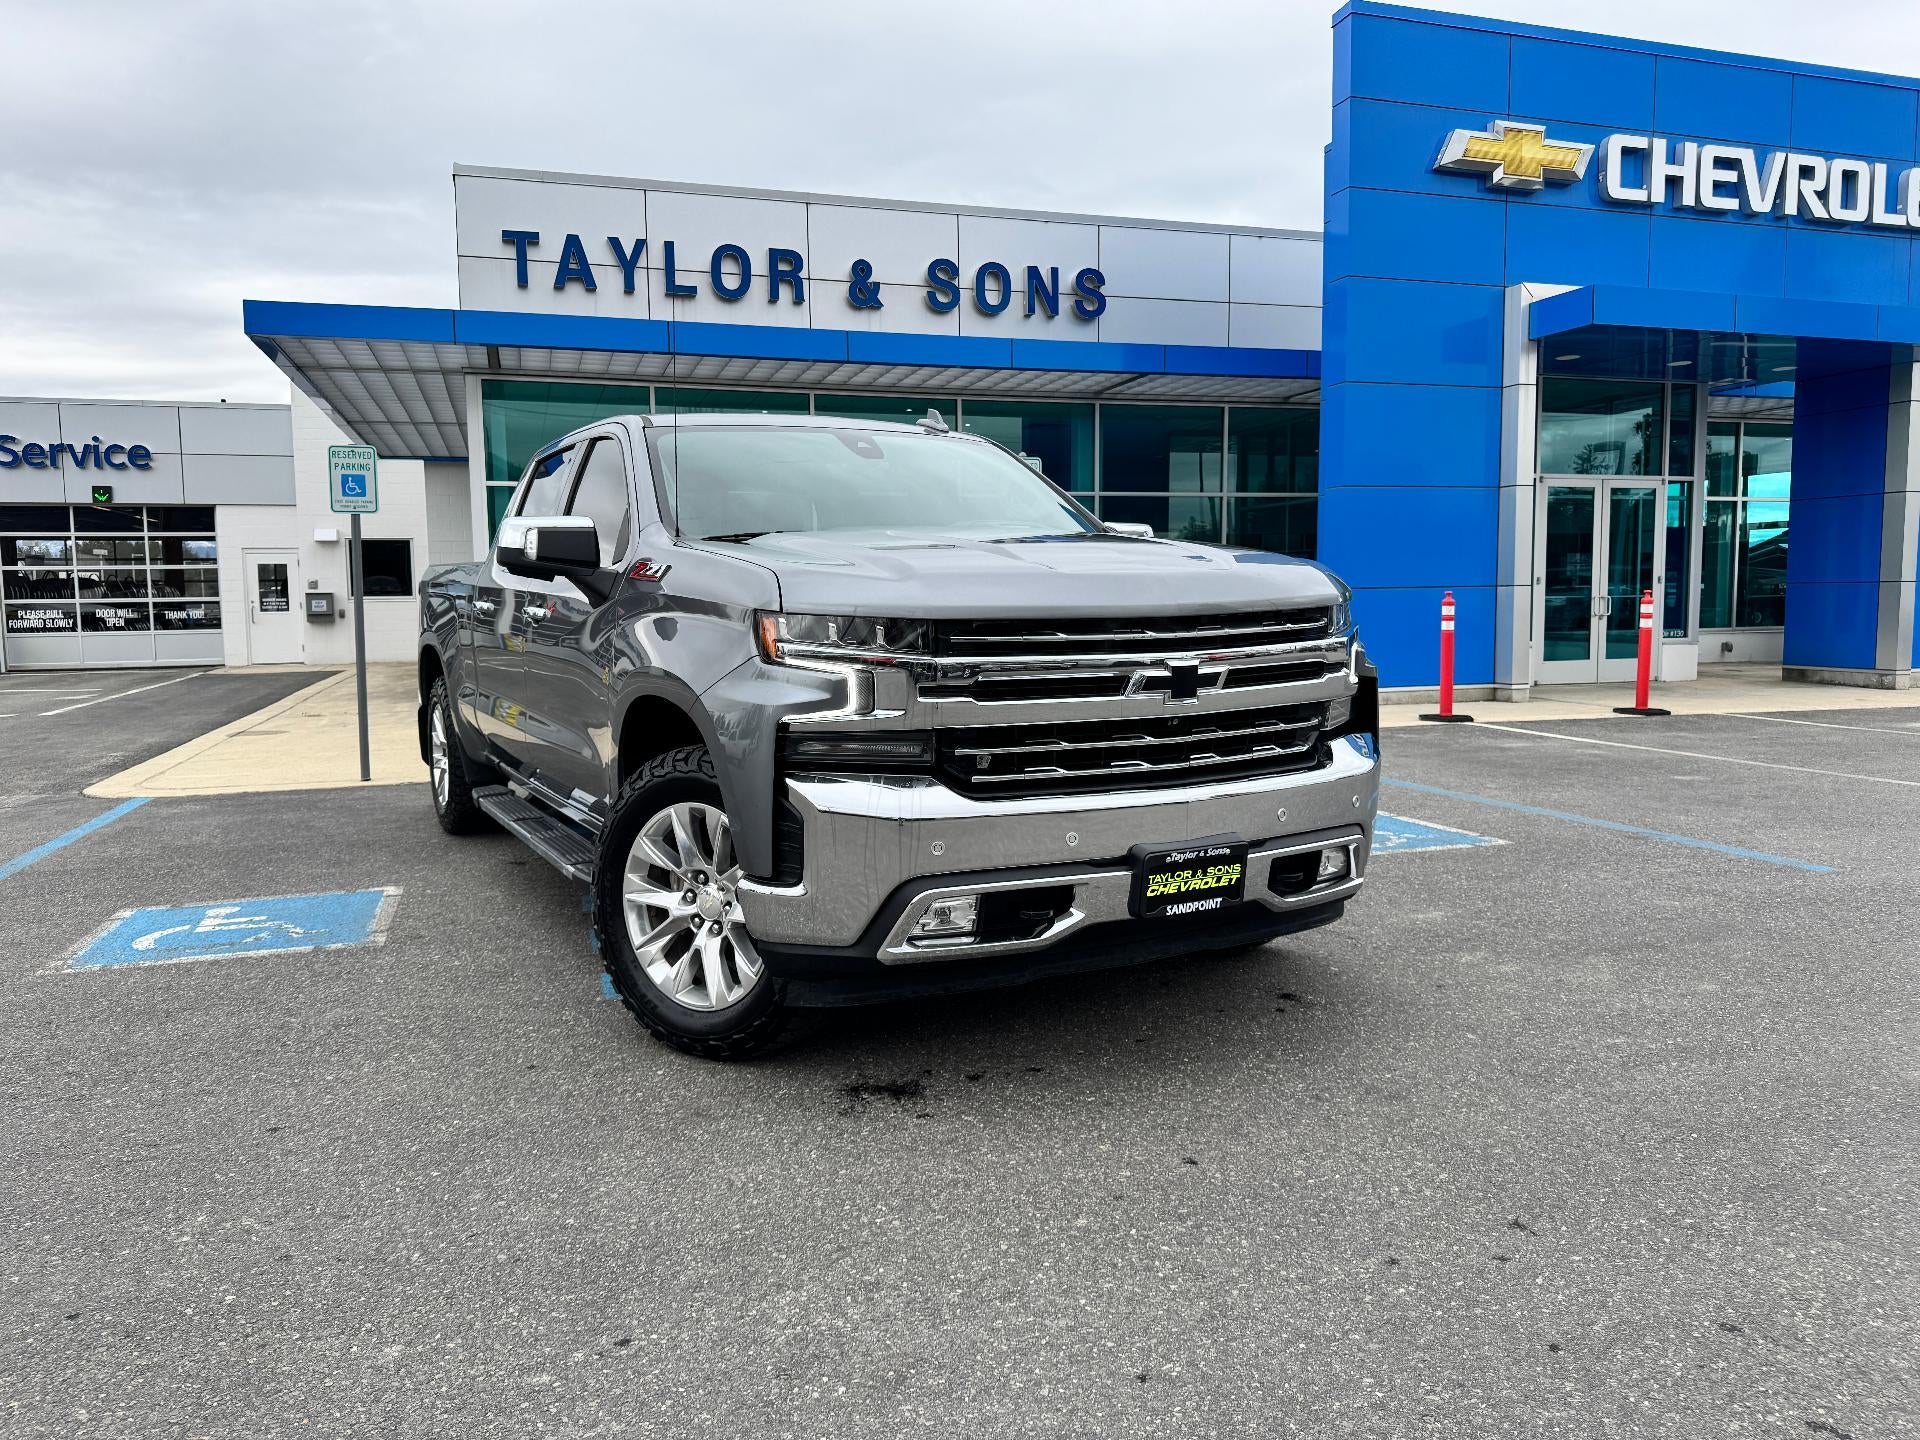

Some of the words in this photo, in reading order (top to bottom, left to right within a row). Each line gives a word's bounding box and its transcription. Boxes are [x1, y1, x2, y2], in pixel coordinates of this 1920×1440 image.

[501, 230, 806, 304] TAYLOR
[848, 258, 883, 309] &
[925, 258, 1107, 319] SONS
[0, 434, 152, 469] Service
[331, 450, 372, 460] RESERVED
[334, 462, 371, 472] PARKING
[630, 561, 670, 581] Z71
[17, 610, 44, 619] PLEASE
[46, 609, 64, 619] PULL
[95, 608, 115, 618] DOOR
[116, 608, 134, 617] WILL
[164, 610, 187, 619] THANK
[8, 619, 44, 629] FORWARD
[45, 618, 74, 628] SLOWLY
[106, 618, 125, 627] OPEN
[1171, 851, 1198, 862] Taylor
[1207, 847, 1227, 856] Sons
[1148, 870, 1192, 885] TAYLOR
[1195, 869, 1203, 879] &
[1207, 864, 1241, 875] SONS
[1146, 875, 1241, 897] CHEVROLET
[1166, 898, 1223, 916] SANDPOINT
